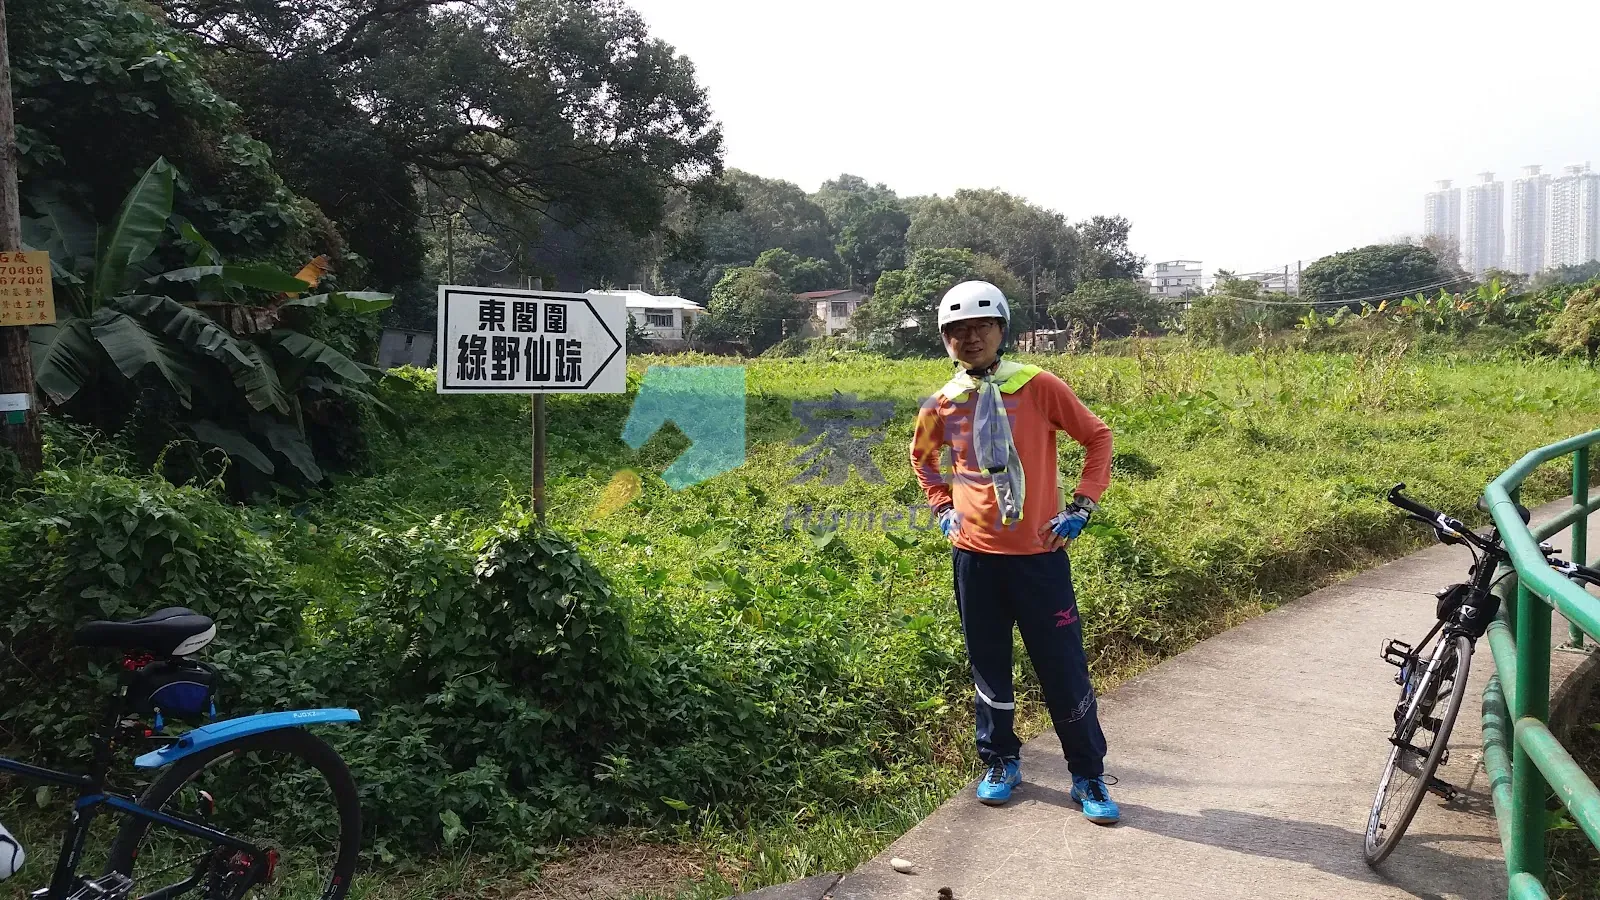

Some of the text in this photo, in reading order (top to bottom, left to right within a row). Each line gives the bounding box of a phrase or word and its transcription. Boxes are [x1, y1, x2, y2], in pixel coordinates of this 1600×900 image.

[479, 299, 567, 333] 東閣圍
[457, 334, 582, 382] 綠野仙踪
